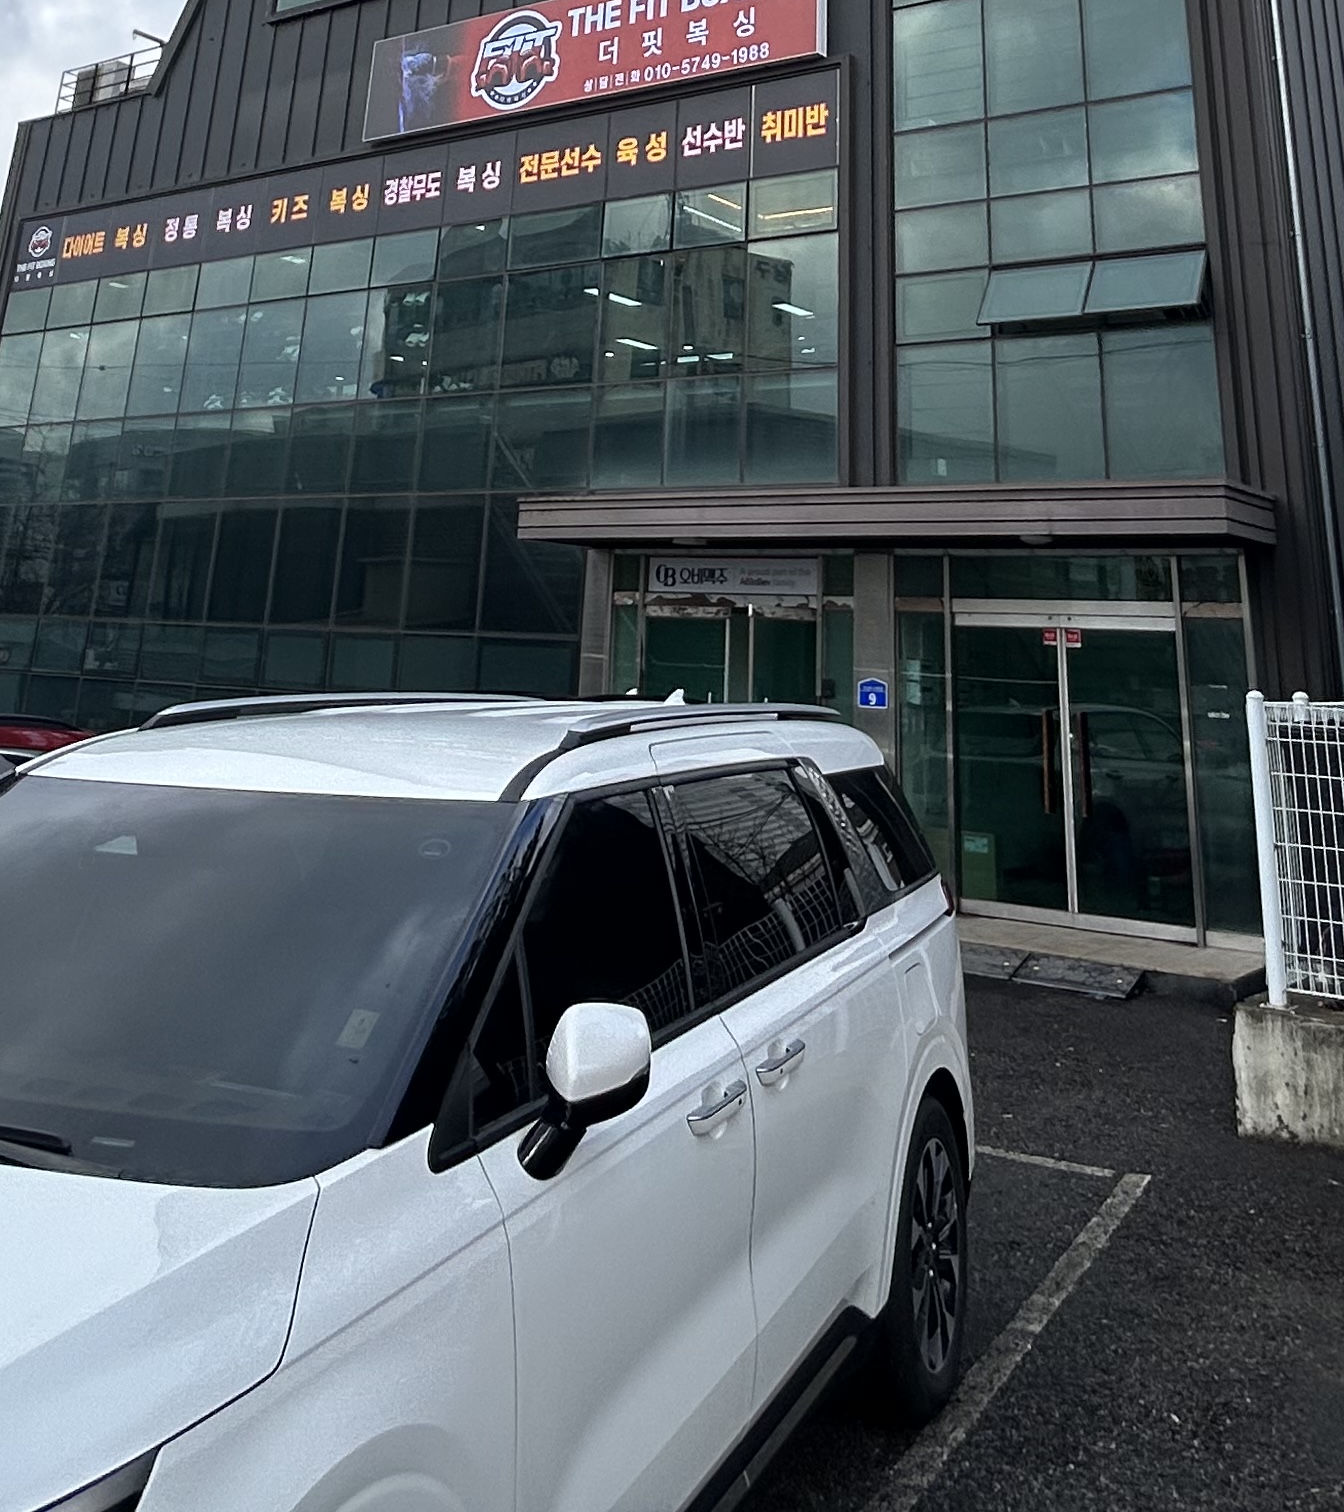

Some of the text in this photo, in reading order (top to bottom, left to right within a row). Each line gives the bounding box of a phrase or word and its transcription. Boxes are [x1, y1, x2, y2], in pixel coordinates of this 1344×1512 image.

[644, 41, 771, 83] 010-5749-1988
[62, 231, 106, 259] 다이어트
[270, 194, 310, 225] 키즈
[384, 171, 442, 206] 경찰무도
[519, 144, 602, 184] 전문선수
[682, 117, 746, 157] 선수반
[761, 102, 829, 144] 취미반
[868, 692, 877, 706] 9
